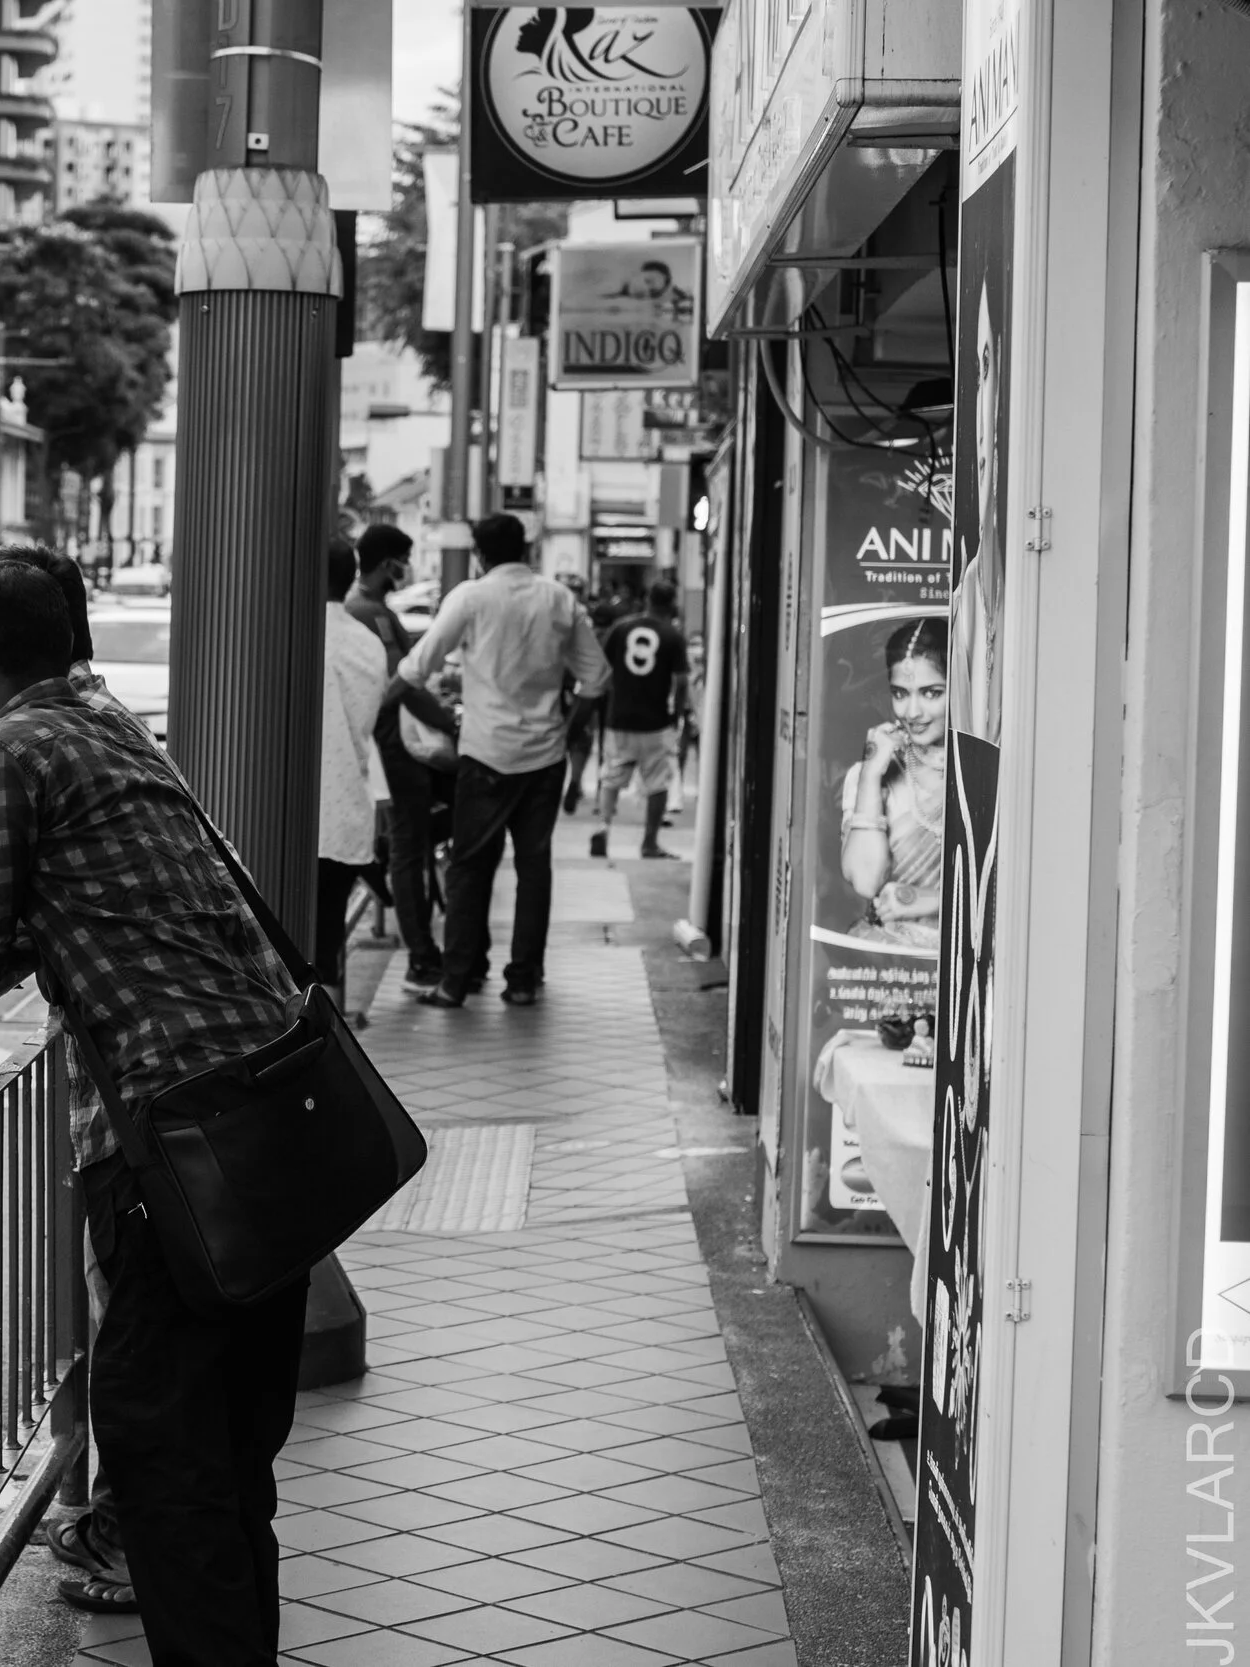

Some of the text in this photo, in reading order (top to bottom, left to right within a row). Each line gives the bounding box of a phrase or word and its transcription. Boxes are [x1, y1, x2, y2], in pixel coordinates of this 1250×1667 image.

[569, 84, 687, 93] INTERNATIONAL
[552, 117, 634, 148] CAFE
[855, 526, 932, 561] ANI
[865, 570, 923, 583] Tradition
[927, 571, 940, 583] of
[920, 586, 950, 600] Sinc
[625, 626, 660, 677] 8
